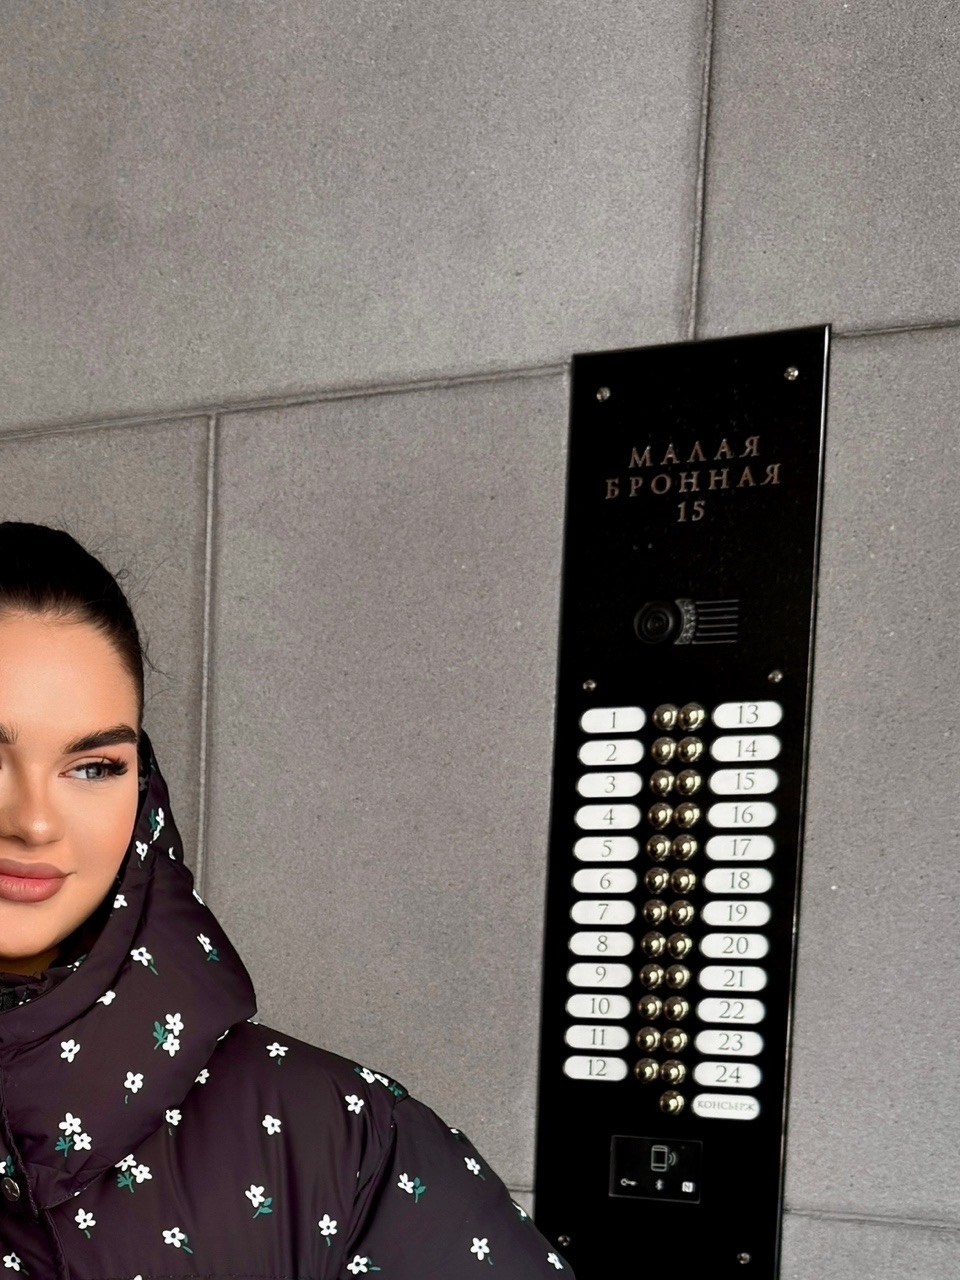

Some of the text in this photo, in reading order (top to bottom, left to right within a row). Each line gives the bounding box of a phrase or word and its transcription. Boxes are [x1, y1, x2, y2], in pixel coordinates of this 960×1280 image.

[628, 435, 760, 468] МАЛАЯ
[605, 463, 782, 499] БРОННАЯ
[677, 500, 705, 522] 15
[736, 703, 760, 725] 13
[604, 743, 617, 762] 2
[737, 739, 758, 758] 14
[604, 775, 617, 794] 3
[736, 771, 756, 791] 15
[602, 807, 615, 826] 4
[733, 805, 754, 824] 16
[601, 839, 613, 858] 5
[732, 837, 753, 857] 17
[599, 872, 612, 890] 6
[729, 871, 751, 890] 18
[597, 902, 610, 921] 7
[727, 903, 748, 922] 19
[596, 934, 609, 953] 8
[721, 935, 750, 955] 20
[594, 965, 607, 983] 9
[722, 968, 744, 988] 21
[590, 996, 611, 1016] 10
[718, 1000, 745, 1020] 22
[590, 1027, 606, 1047] 11
[717, 1032, 744, 1052] 23
[587, 1058, 609, 1077] 12
[715, 1064, 742, 1084] 24
